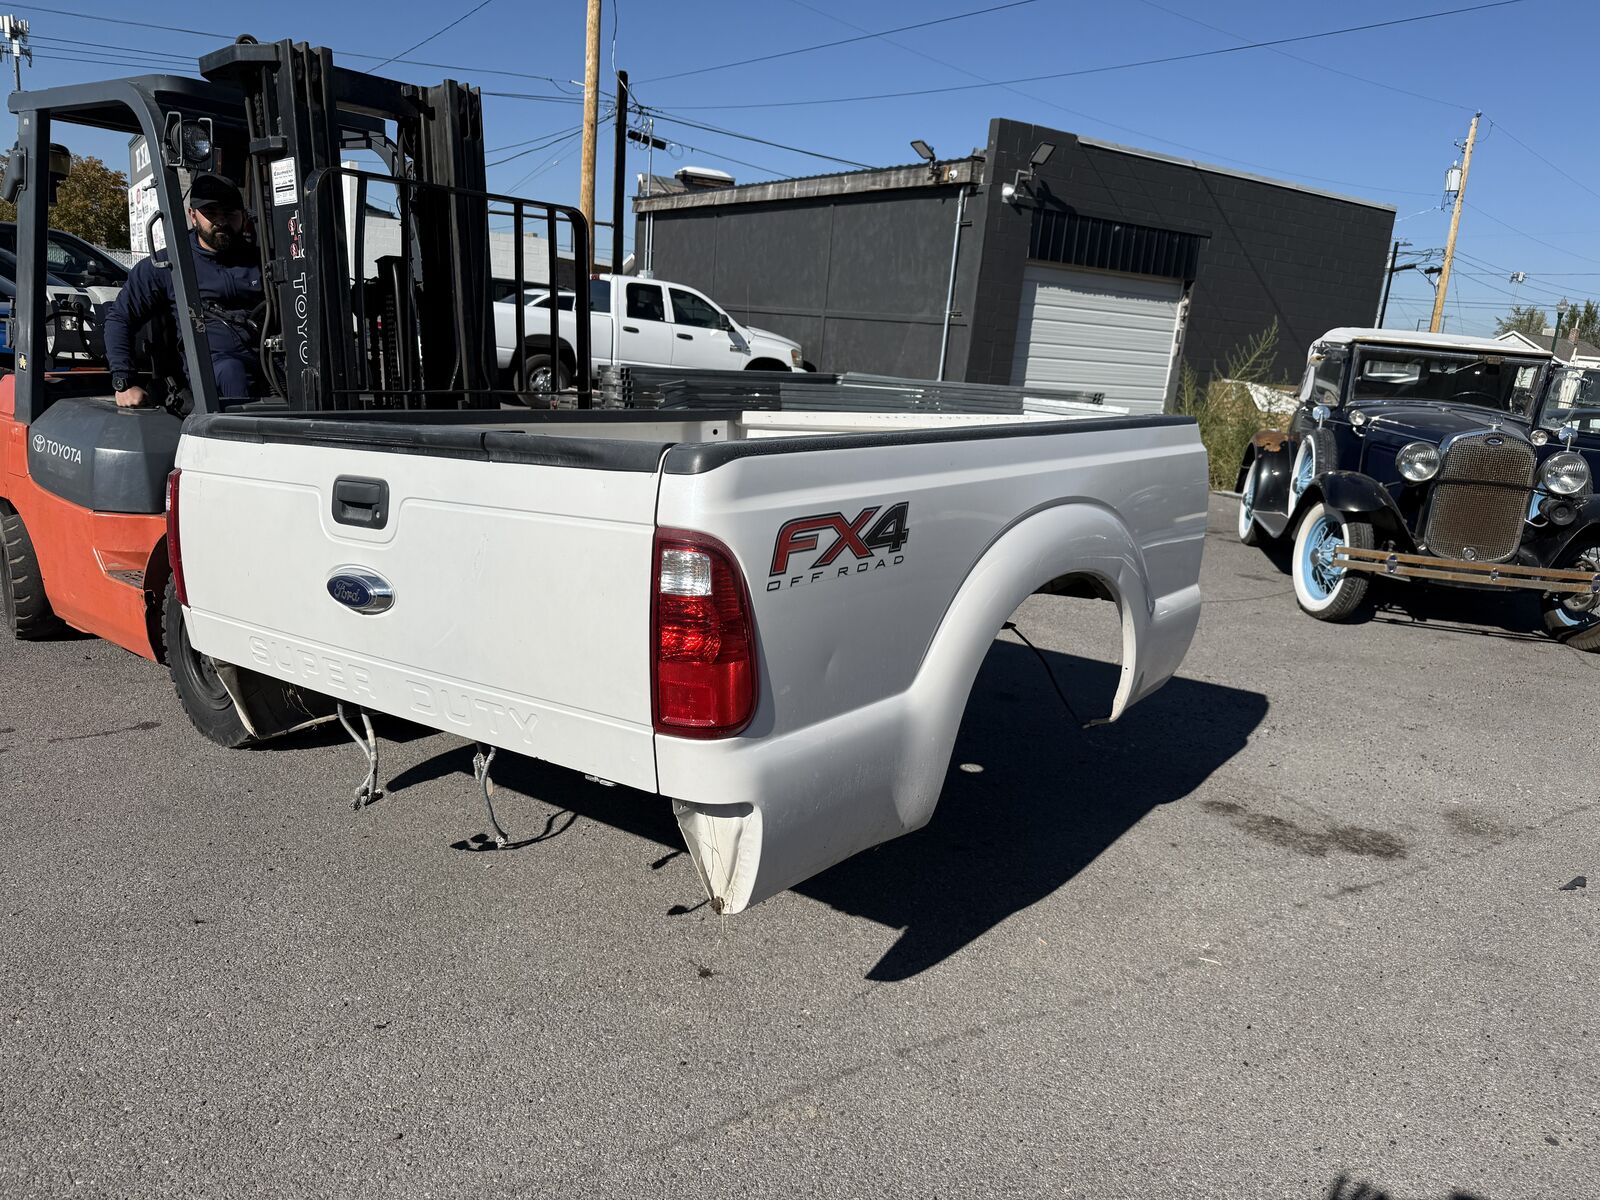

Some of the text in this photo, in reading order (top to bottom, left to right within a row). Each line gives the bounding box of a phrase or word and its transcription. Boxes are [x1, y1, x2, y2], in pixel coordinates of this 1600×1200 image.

[46, 439, 82, 465] TOYOTA
[768, 501, 910, 578] FX4
[333, 579, 361, 602] Ford
[766, 555, 905, 592] OFF ROAD
[249, 635, 540, 745] SUPER DUTY
